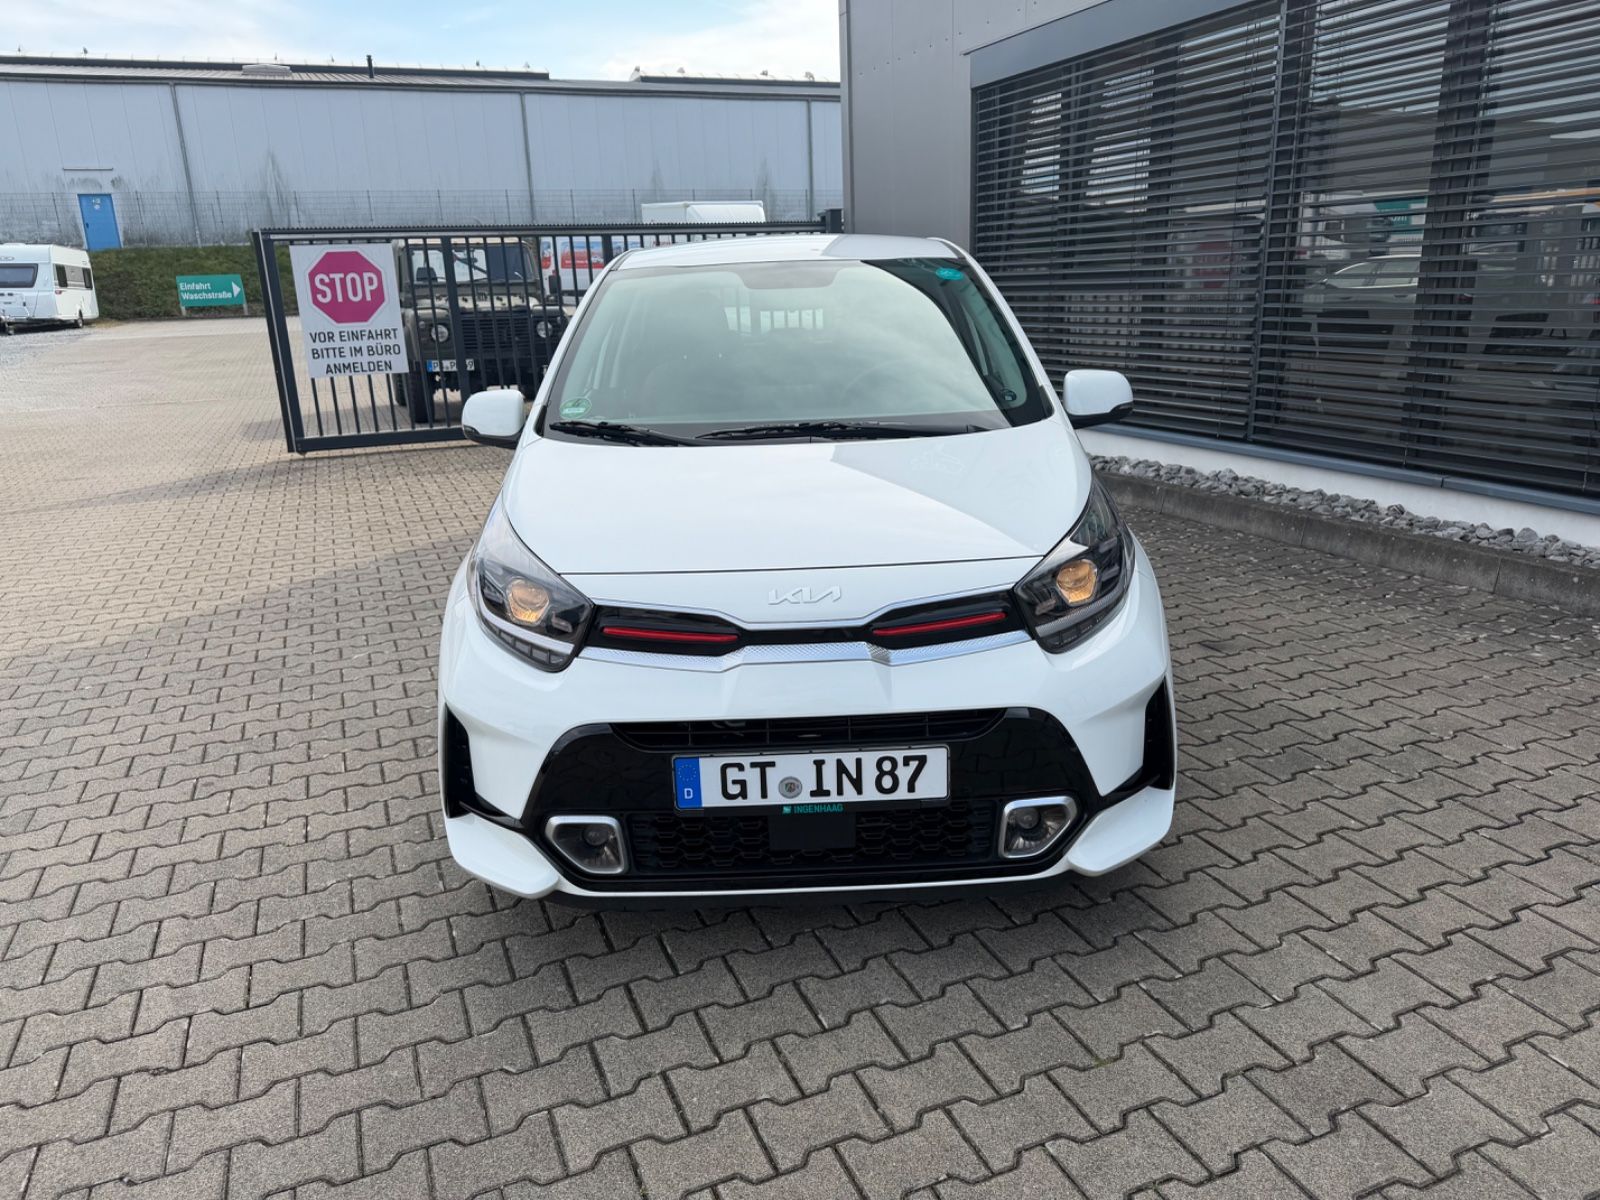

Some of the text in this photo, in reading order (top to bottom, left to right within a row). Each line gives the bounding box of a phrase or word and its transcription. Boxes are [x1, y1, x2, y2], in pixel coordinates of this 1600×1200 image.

[180, 282, 211, 291] Einfahrt
[314, 272, 378, 303] STOP
[181, 291, 232, 300] Waschstraße
[309, 328, 398, 343] VOR EINFAHRT
[311, 342, 401, 360] BITTE IM BÜRO
[325, 360, 392, 375] ANMELDEN
[768, 585, 842, 605] KIA
[684, 754, 928, 800] D GT IN 87
[794, 803, 844, 814] INGENHAAG
